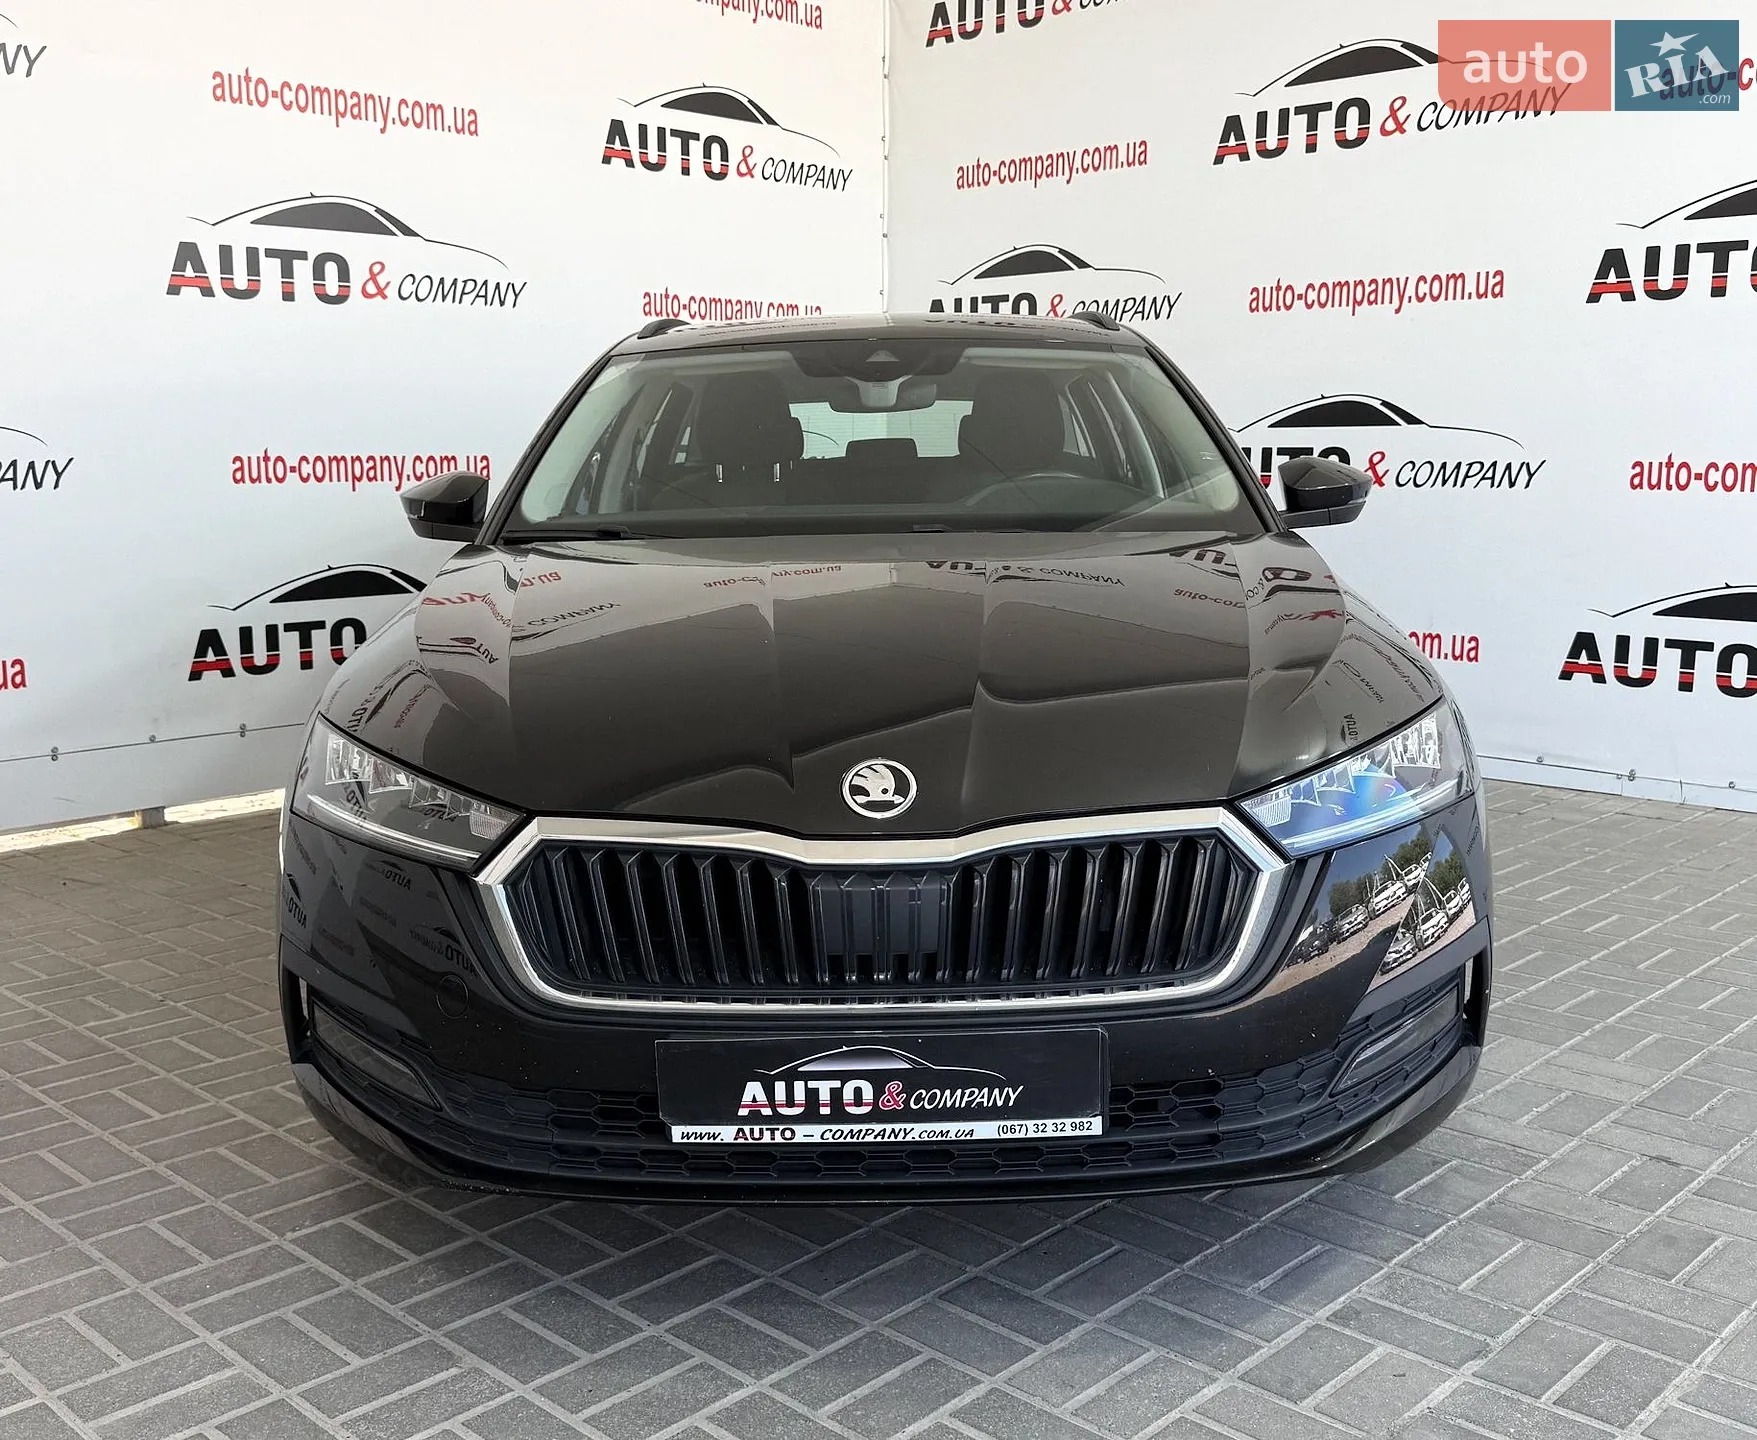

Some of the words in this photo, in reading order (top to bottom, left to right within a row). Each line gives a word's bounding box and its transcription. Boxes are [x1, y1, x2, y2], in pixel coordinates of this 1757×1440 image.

[212, 67, 479, 137] auto-company.com.ua
[1213, 97, 1371, 165] AUTO
[1379, 96, 1411, 137] &
[1417, 83, 1573, 132] COMPANY
[602, 119, 730, 181] AUTO
[736, 145, 756, 179] &
[761, 157, 853, 192] COMPANY
[956, 139, 1148, 190] auto-company.com.ua
[166, 241, 351, 305] AUTO
[361, 260, 391, 301] &
[397, 273, 528, 309] COMPANY
[1248, 268, 1505, 317] auto-company.com.ua
[1586, 240, 1757, 304] AUT
[0, 457, 74, 491] ANY
[231, 448, 491, 492] auto-company.comua
[1395, 459, 1546, 490] COMPANY
[188, 617, 367, 682] AUTO
[1558, 631, 1757, 698] AUTO
[737, 1079, 874, 1116] AUTO
[879, 1080, 906, 1111] &
[910, 1085, 1024, 1110] COMPANY
[733, 1127, 796, 1141] AUTO
[820, 1127, 974, 1141] COMPANY.COM.UA
[997, 1123, 1029, 1137] (067)
[1033, 1122, 1048, 1134] 32
[1052, 1121, 1067, 1133] 32
[1070, 1120, 1093, 1132] 982
